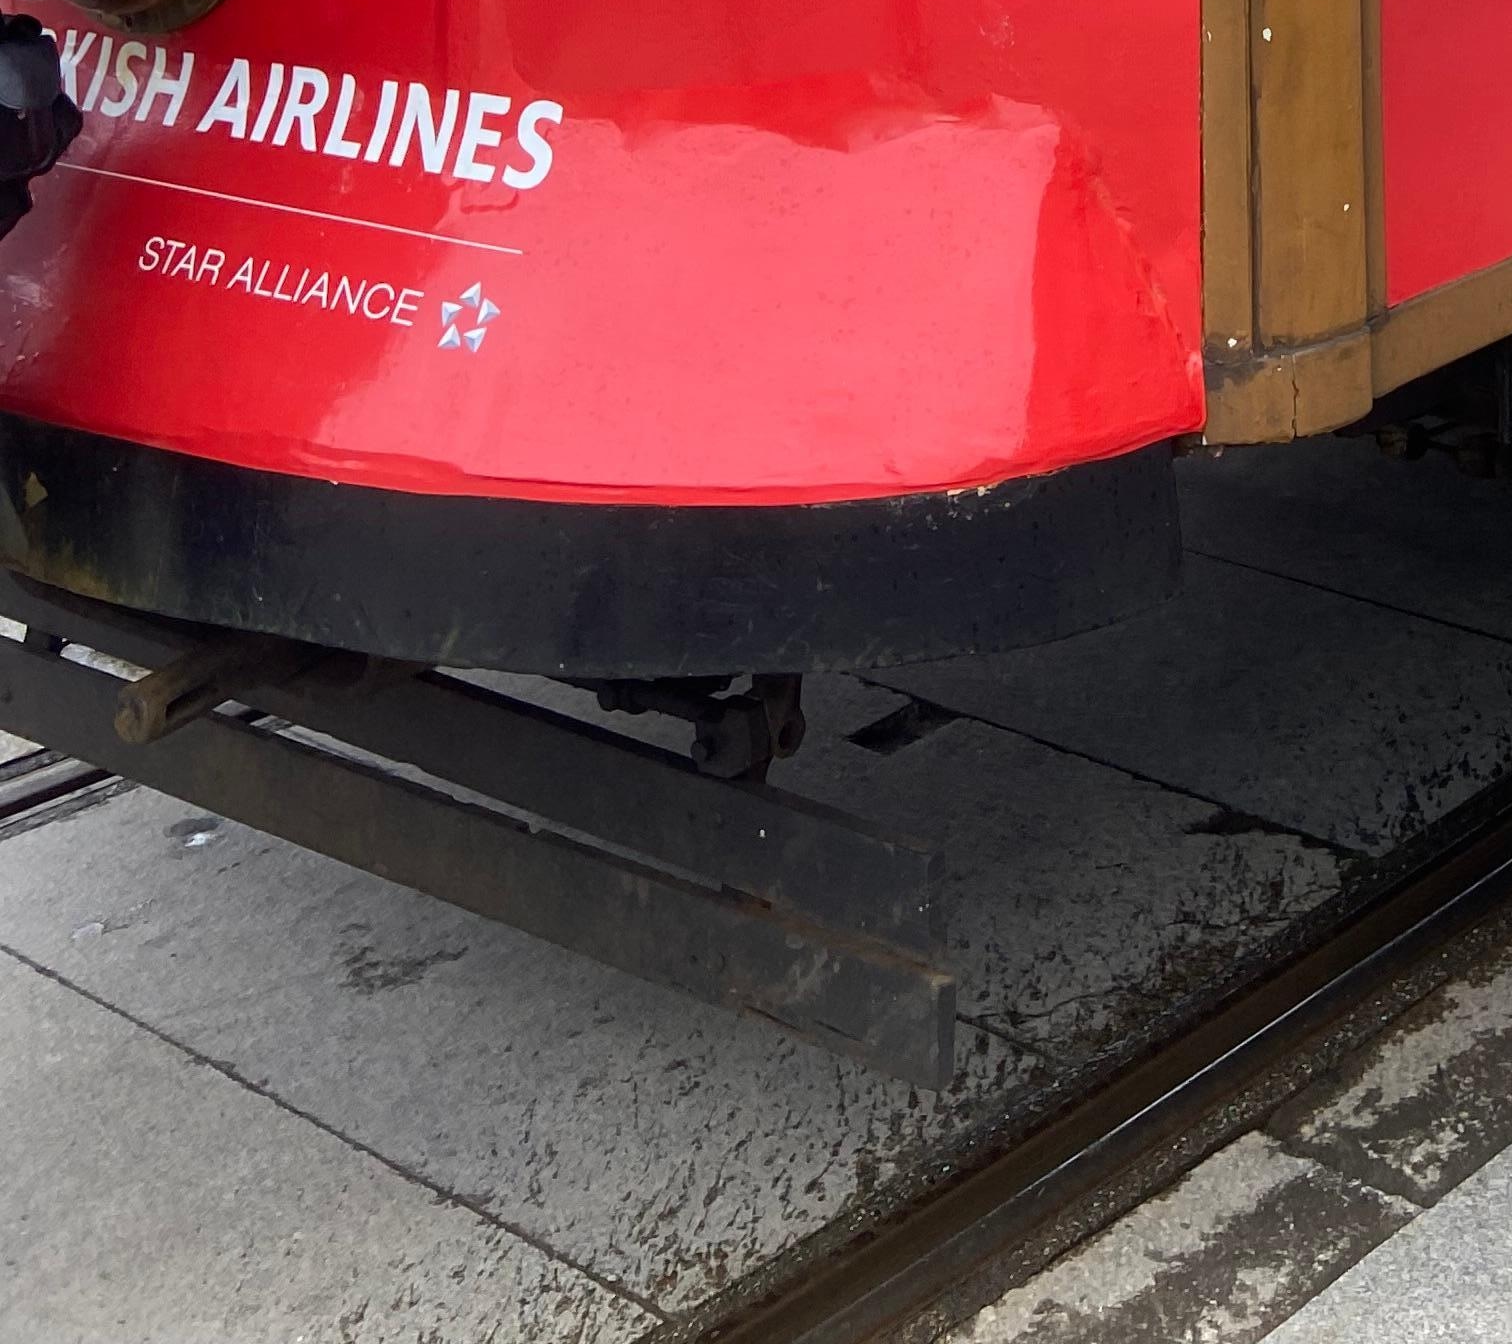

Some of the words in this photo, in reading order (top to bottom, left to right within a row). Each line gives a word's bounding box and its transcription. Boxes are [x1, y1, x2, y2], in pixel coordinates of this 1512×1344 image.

[41, 27, 195, 127] KISH
[196, 58, 564, 191] AIRLINES
[138, 236, 226, 287] STAR
[227, 259, 425, 327] ALLIANCE
